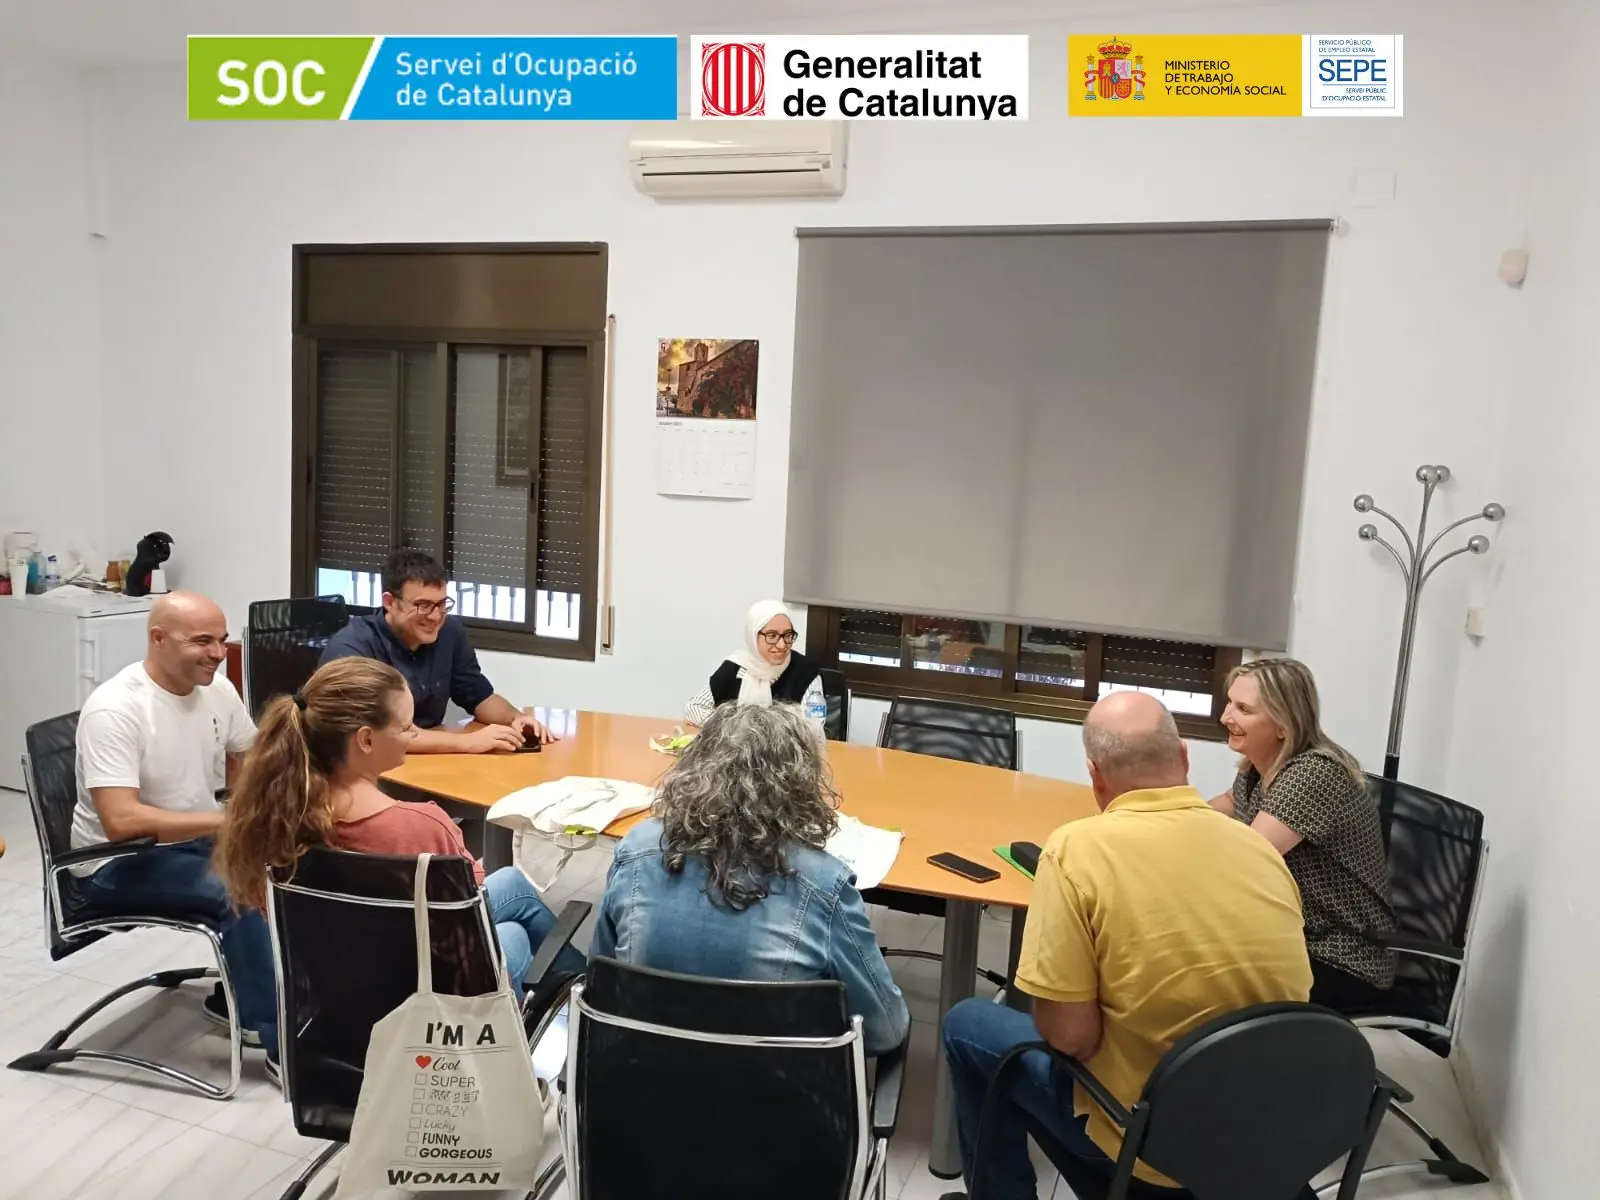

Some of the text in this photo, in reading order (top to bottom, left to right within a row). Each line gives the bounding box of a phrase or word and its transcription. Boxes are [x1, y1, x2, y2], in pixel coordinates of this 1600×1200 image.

[425, 1022, 496, 1047] I'M A
[432, 1056, 461, 1072] Cool
[430, 1074, 476, 1088] SUPER
[425, 1103, 469, 1118] CRAZY
[423, 1118, 456, 1133] Lucky
[422, 1132, 461, 1147] FUNNY
[419, 1147, 493, 1160] GORGEOUS
[387, 1168, 501, 1187] WOMAN
